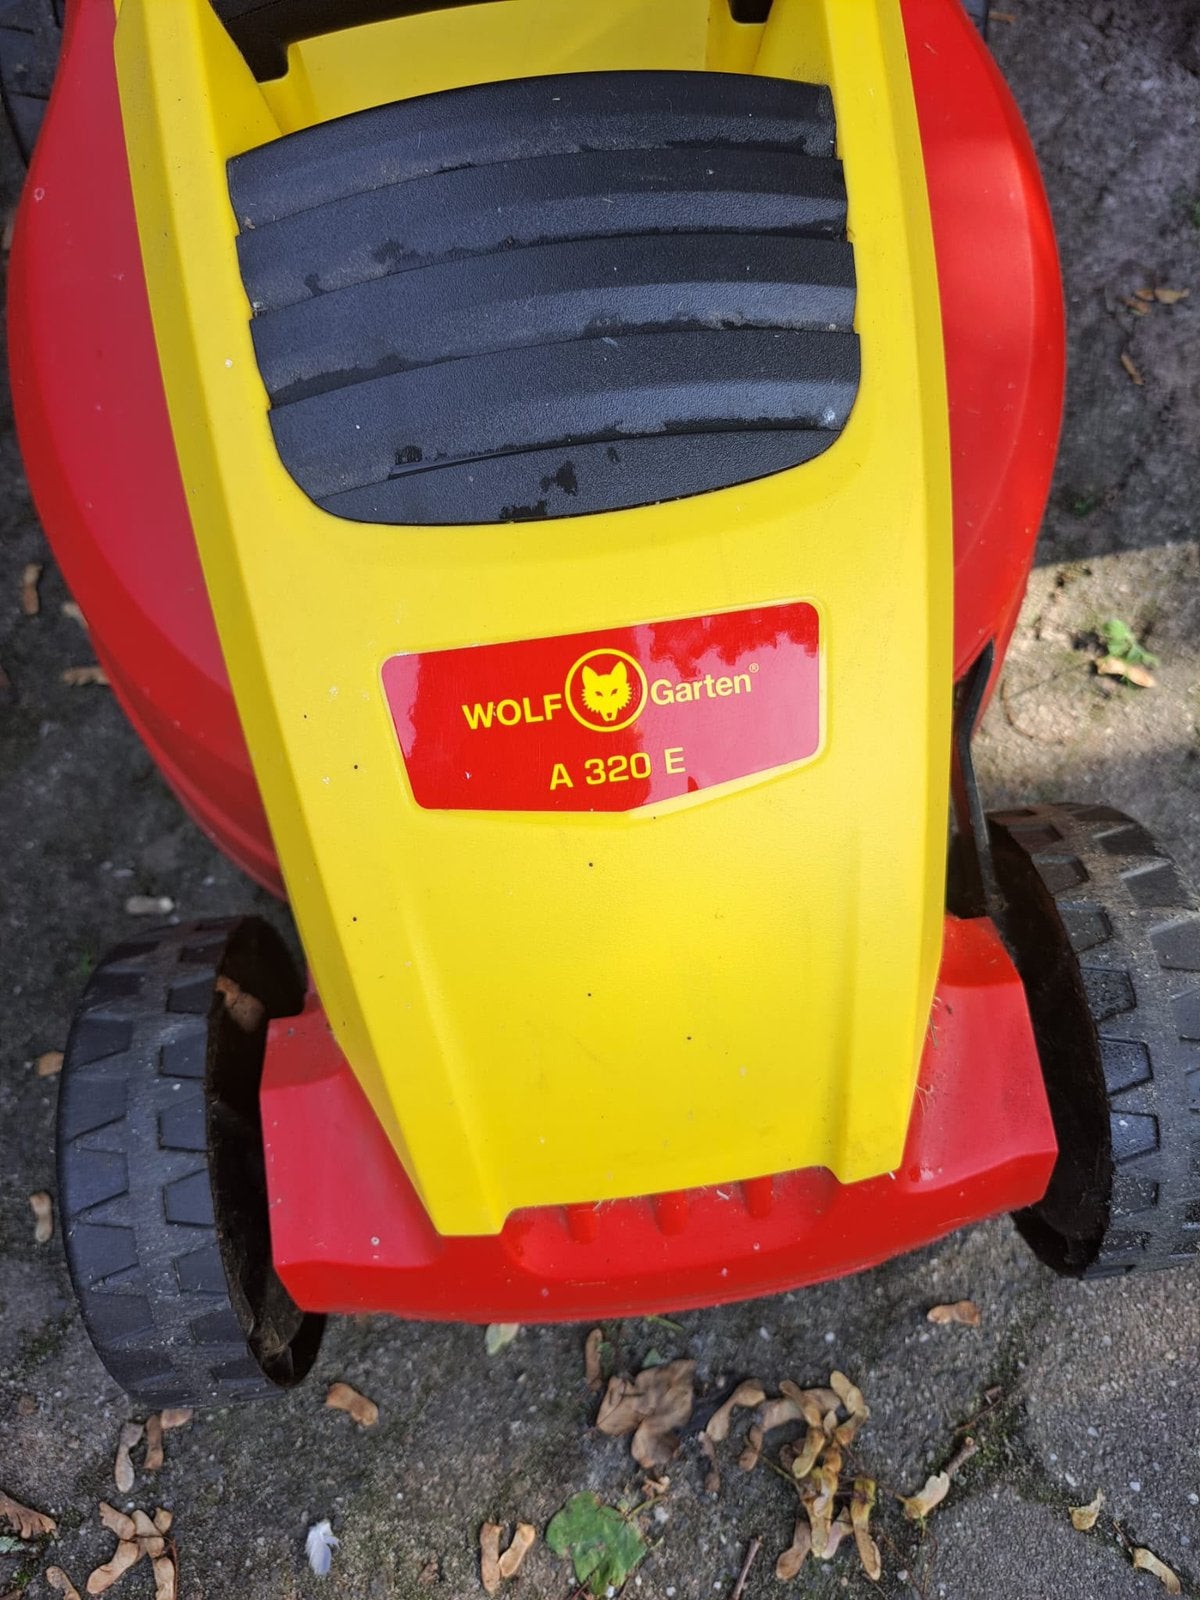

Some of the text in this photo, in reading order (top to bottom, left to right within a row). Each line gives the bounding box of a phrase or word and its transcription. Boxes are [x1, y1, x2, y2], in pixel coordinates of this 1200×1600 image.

[462, 694, 562, 729] WOLF
[549, 748, 685, 790] A 320 E
